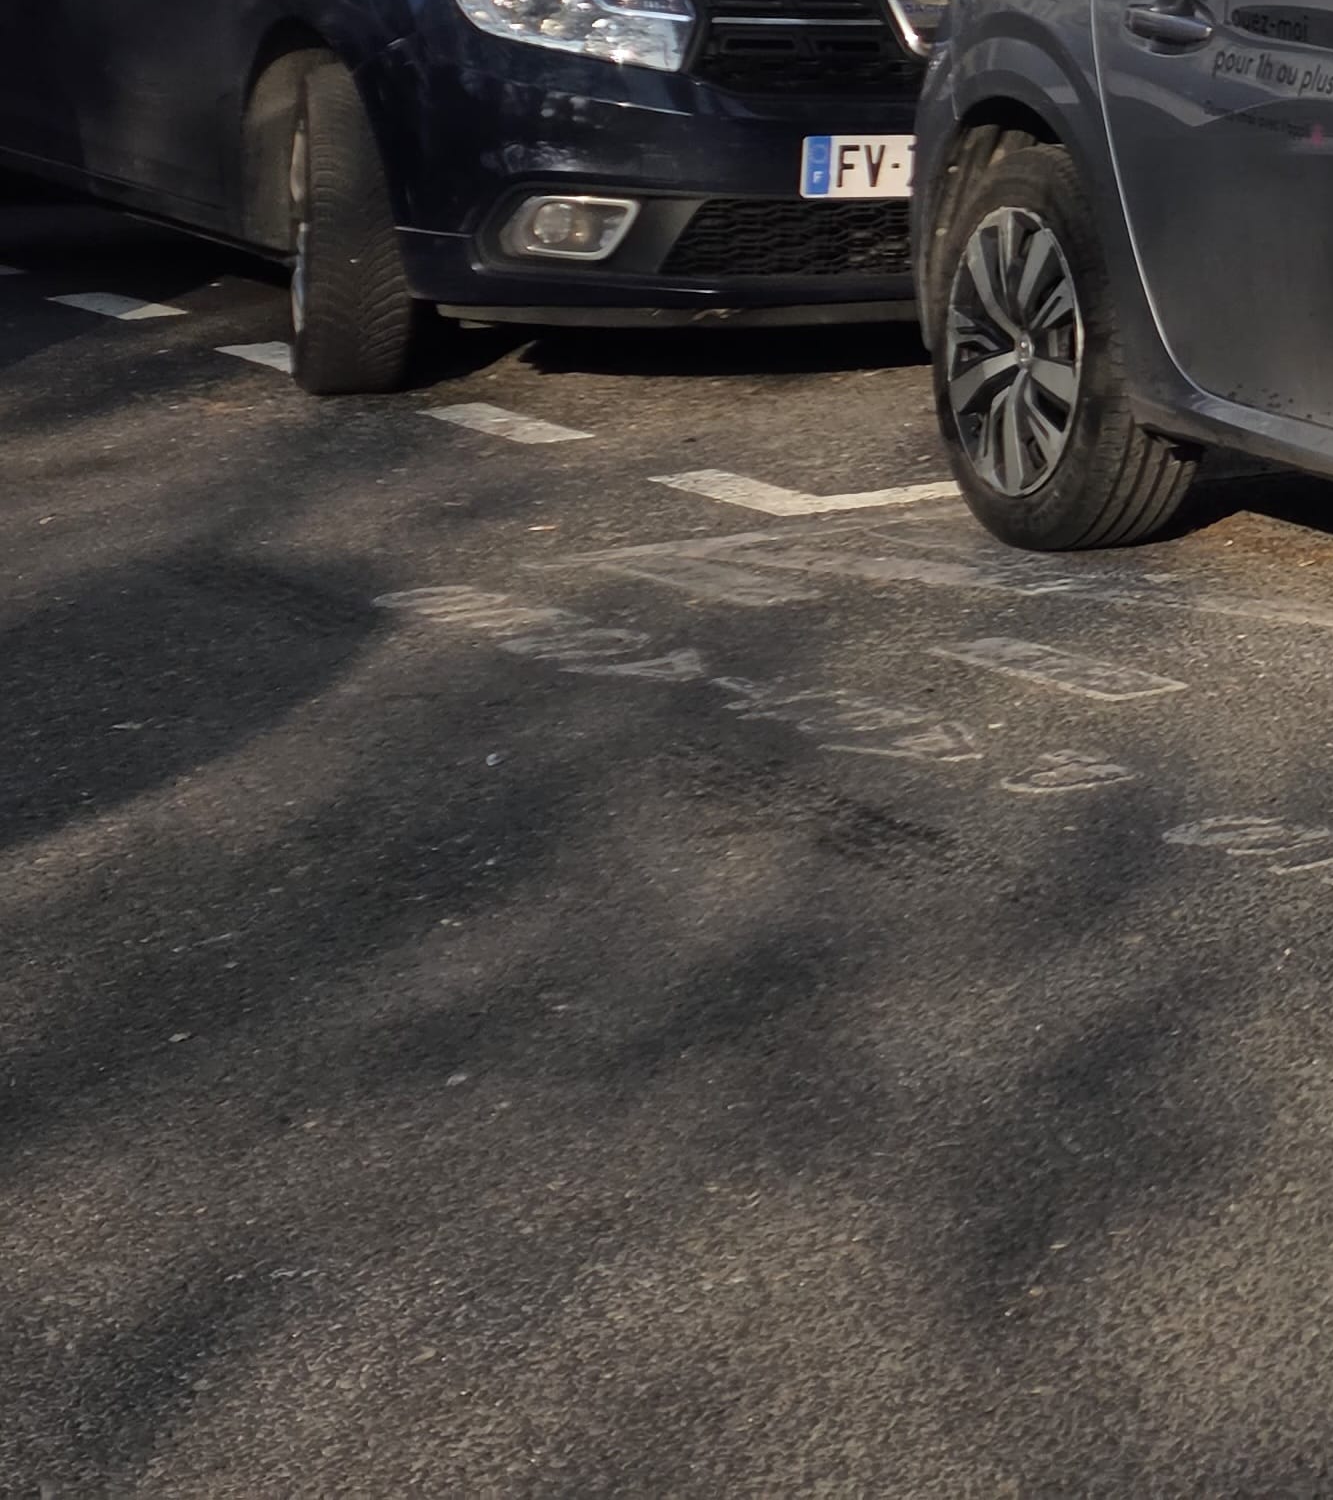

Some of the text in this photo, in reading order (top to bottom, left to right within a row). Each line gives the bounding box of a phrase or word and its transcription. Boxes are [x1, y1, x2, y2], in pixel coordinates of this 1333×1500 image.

[1223, 0, 1310, 41] Louez-moi
[1212, 51, 1254, 78] pour
[1256, 53, 1274, 81] 1h
[1276, 62, 1298, 85] ou
